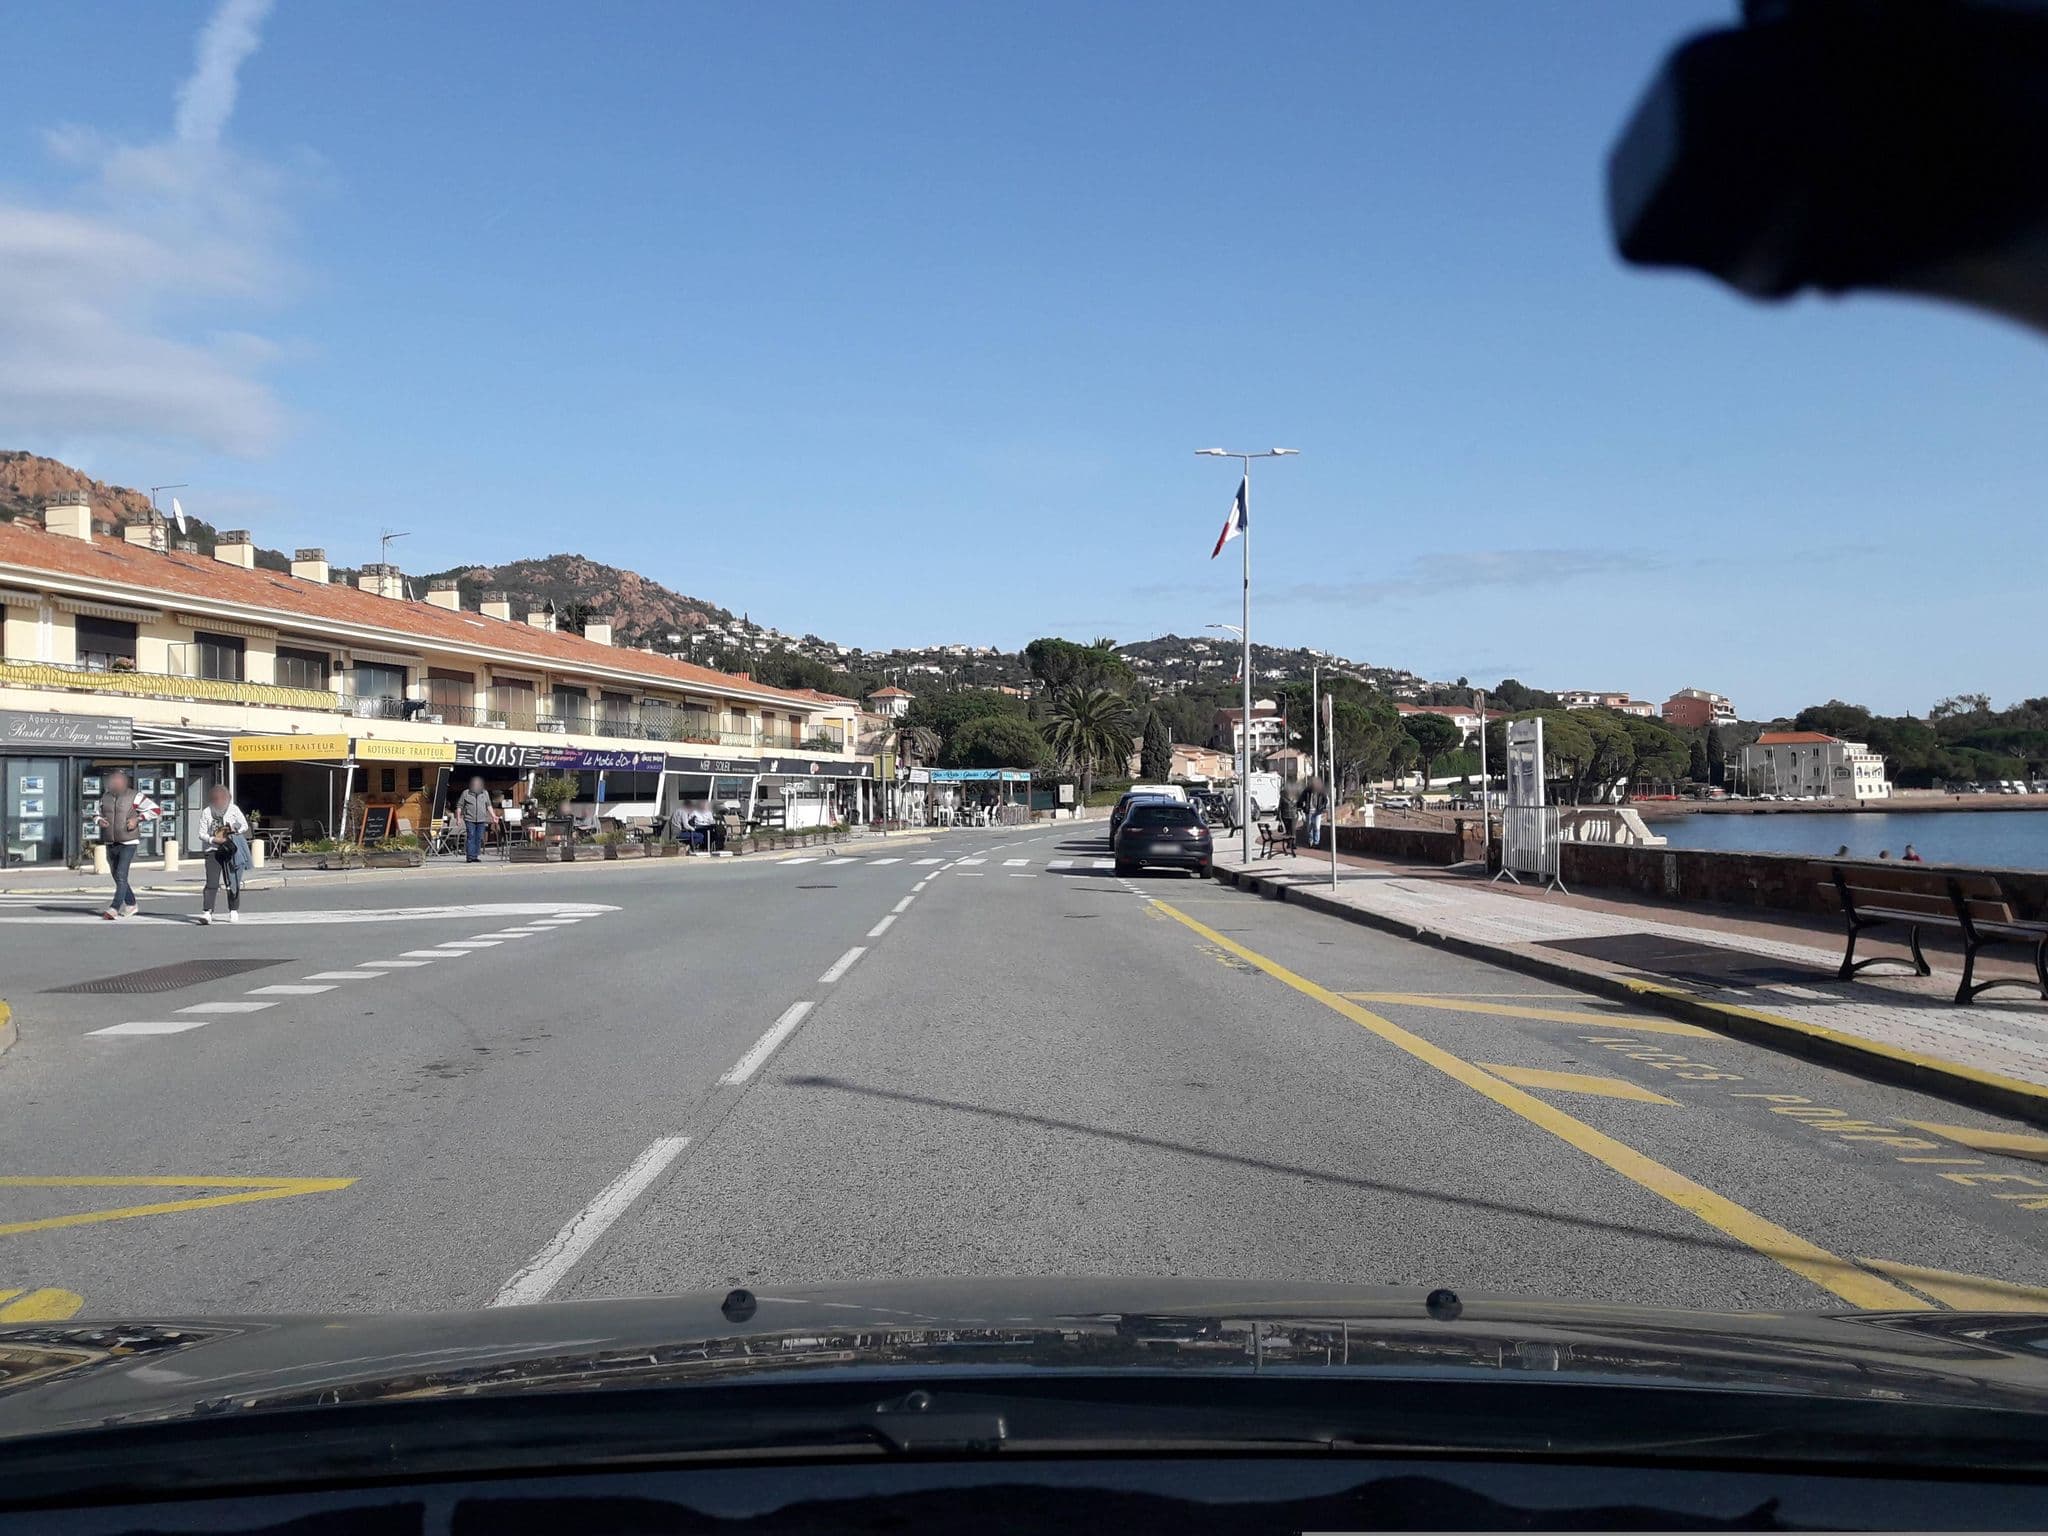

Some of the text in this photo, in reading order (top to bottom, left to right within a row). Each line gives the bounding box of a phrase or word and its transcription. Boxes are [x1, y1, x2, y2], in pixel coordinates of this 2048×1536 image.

[28, 714, 70, 725] Agence du
[8, 719, 50, 738] Rastel
[237, 743, 283, 753] ROTISSERIE
[289, 742, 335, 751] TRAITEUR
[367, 745, 445, 757] ROTISSERIE TRAITEUR
[473, 744, 527, 767] COAST
[582, 752, 592, 766] Le
[1577, 1036, 1745, 1081] ACCES
